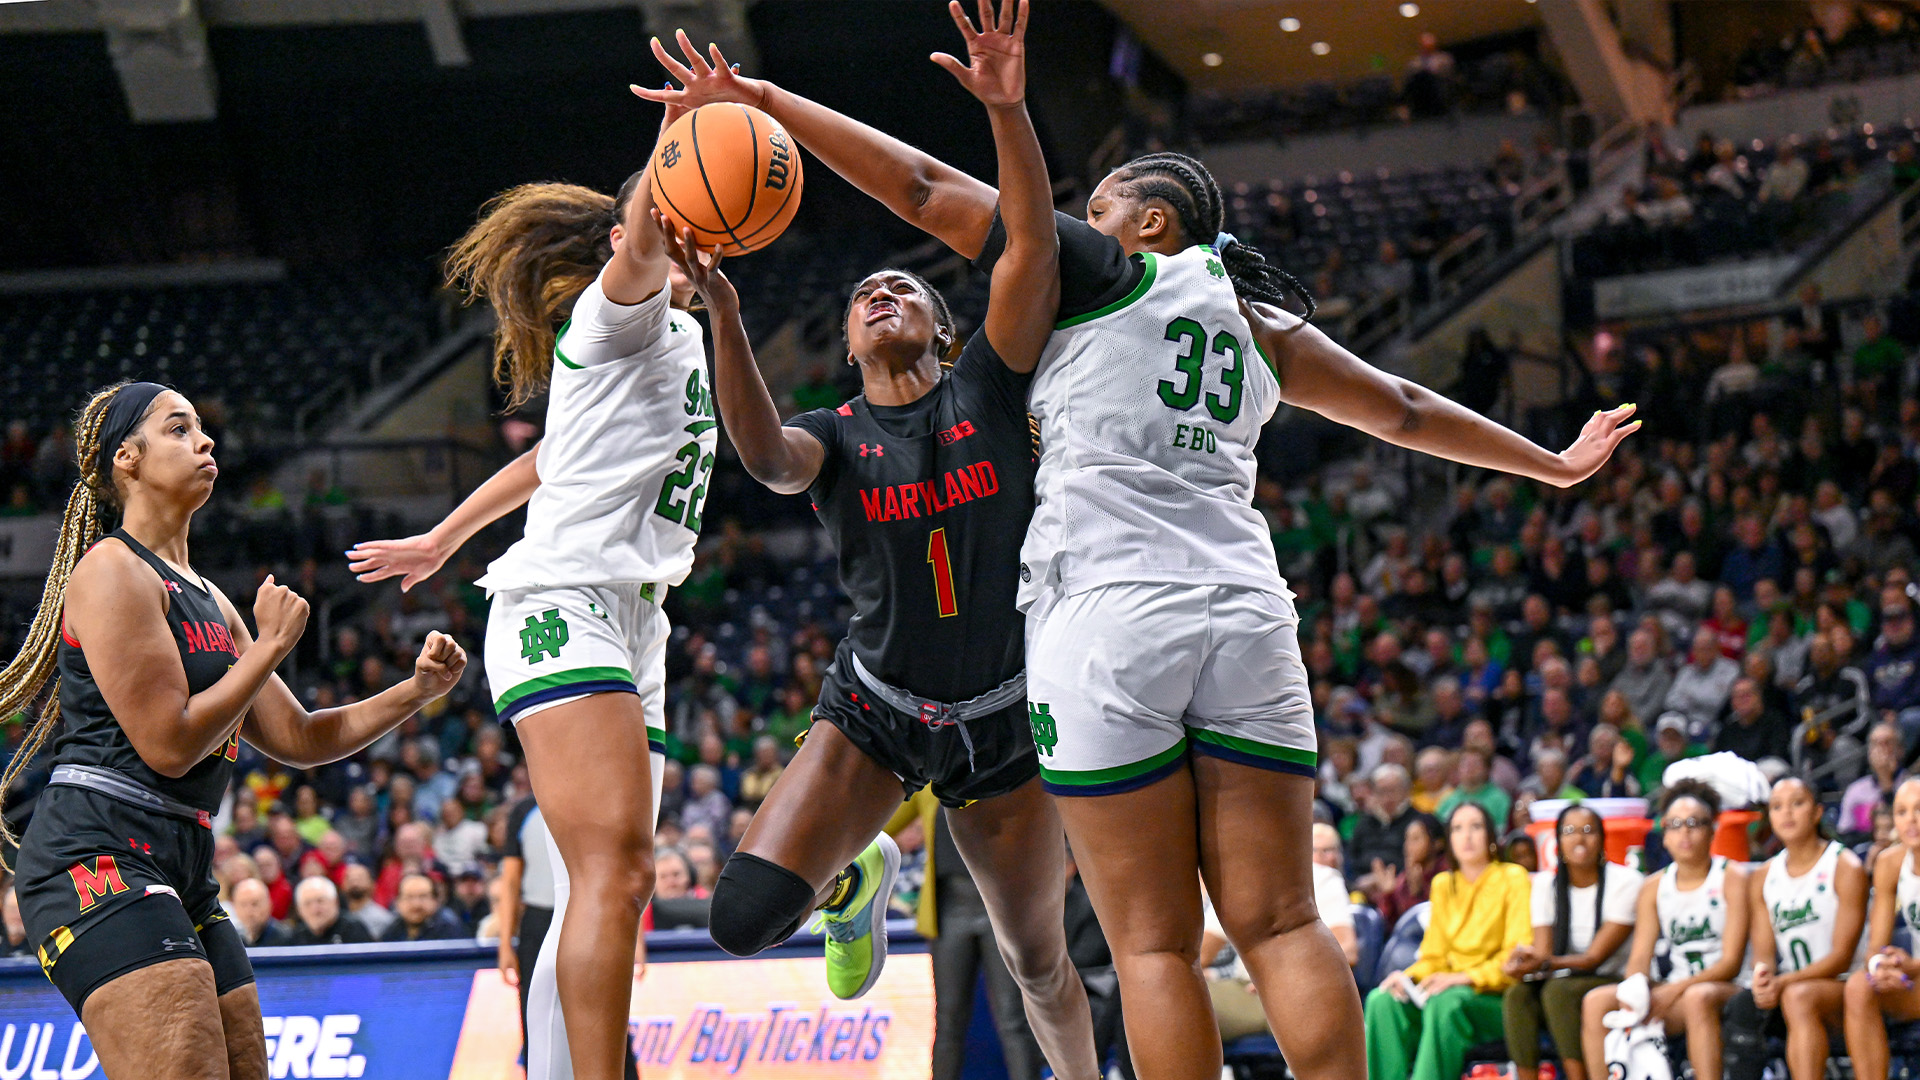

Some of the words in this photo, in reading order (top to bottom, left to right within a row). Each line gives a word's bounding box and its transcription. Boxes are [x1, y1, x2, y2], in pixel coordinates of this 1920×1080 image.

[1156, 315, 1245, 425] 33
[1172, 423, 1217, 454] EBO
[653, 440, 715, 536] 22
[858, 460, 1000, 523] MARYLAND
[926, 527, 959, 619] 1
[66, 854, 131, 915] M
